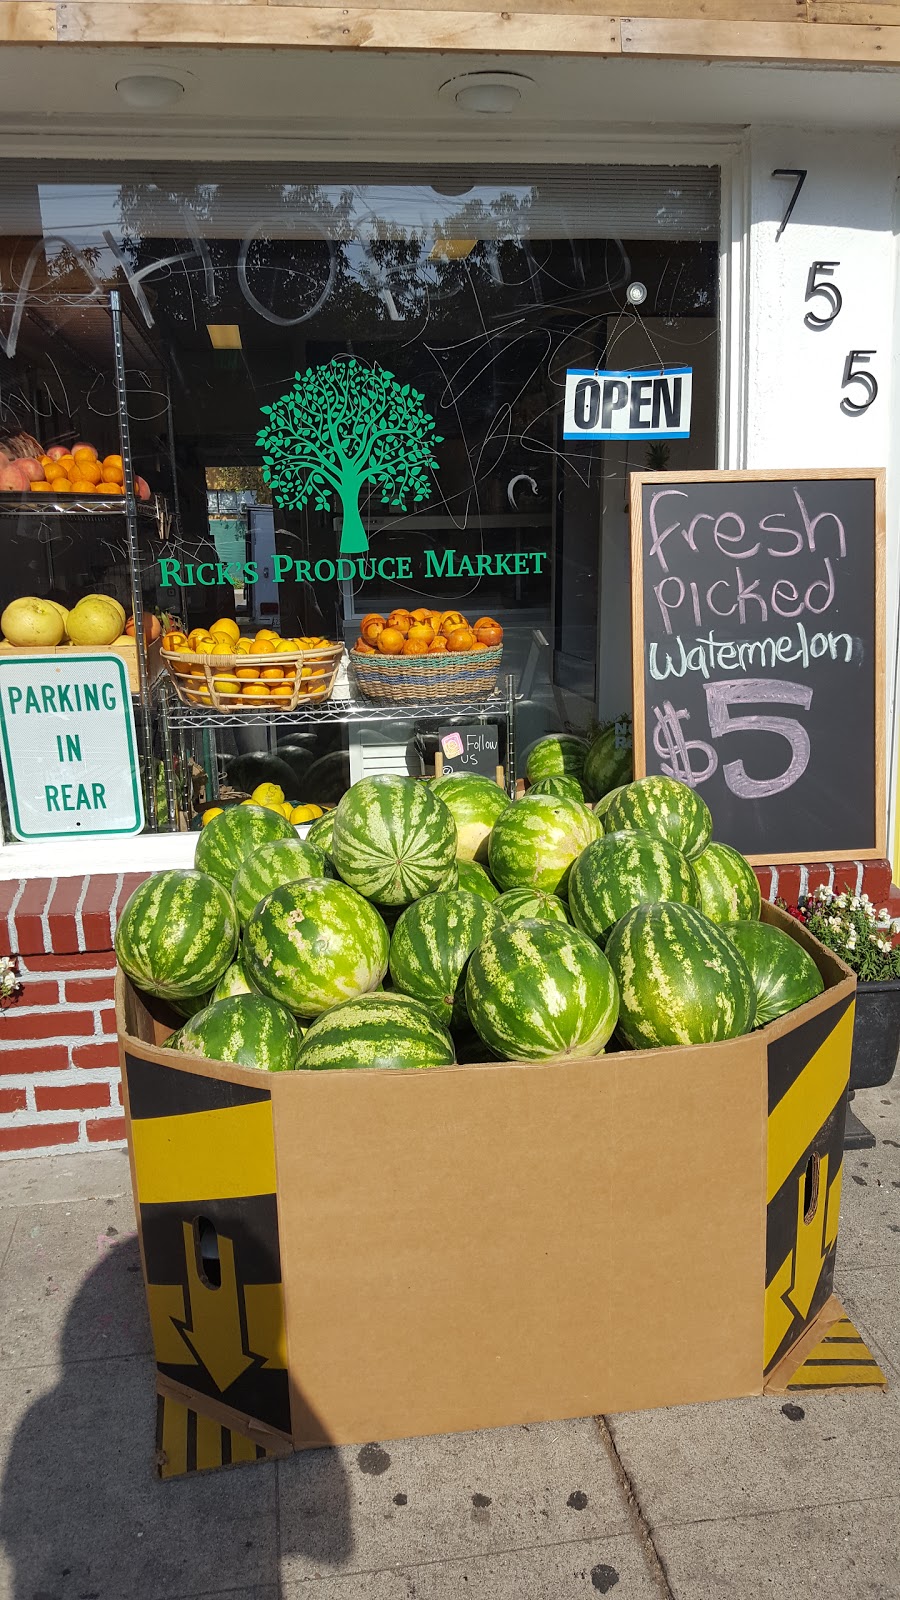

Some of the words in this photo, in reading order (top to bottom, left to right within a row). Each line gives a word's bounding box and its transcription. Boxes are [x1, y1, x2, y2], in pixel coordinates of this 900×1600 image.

[574, 377, 682, 430] OPEN
[158, 559, 259, 587] RICK'S
[271, 555, 413, 583] PRODUCE
[423, 550, 547, 578] MARKET
[650, 622, 854, 681] Watermelon
[8, 683, 117, 714] PARKING
[56, 734, 82, 762] IN
[466, 734, 498, 752] Follow
[653, 678, 813, 800] $5
[45, 783, 107, 812] REAR
